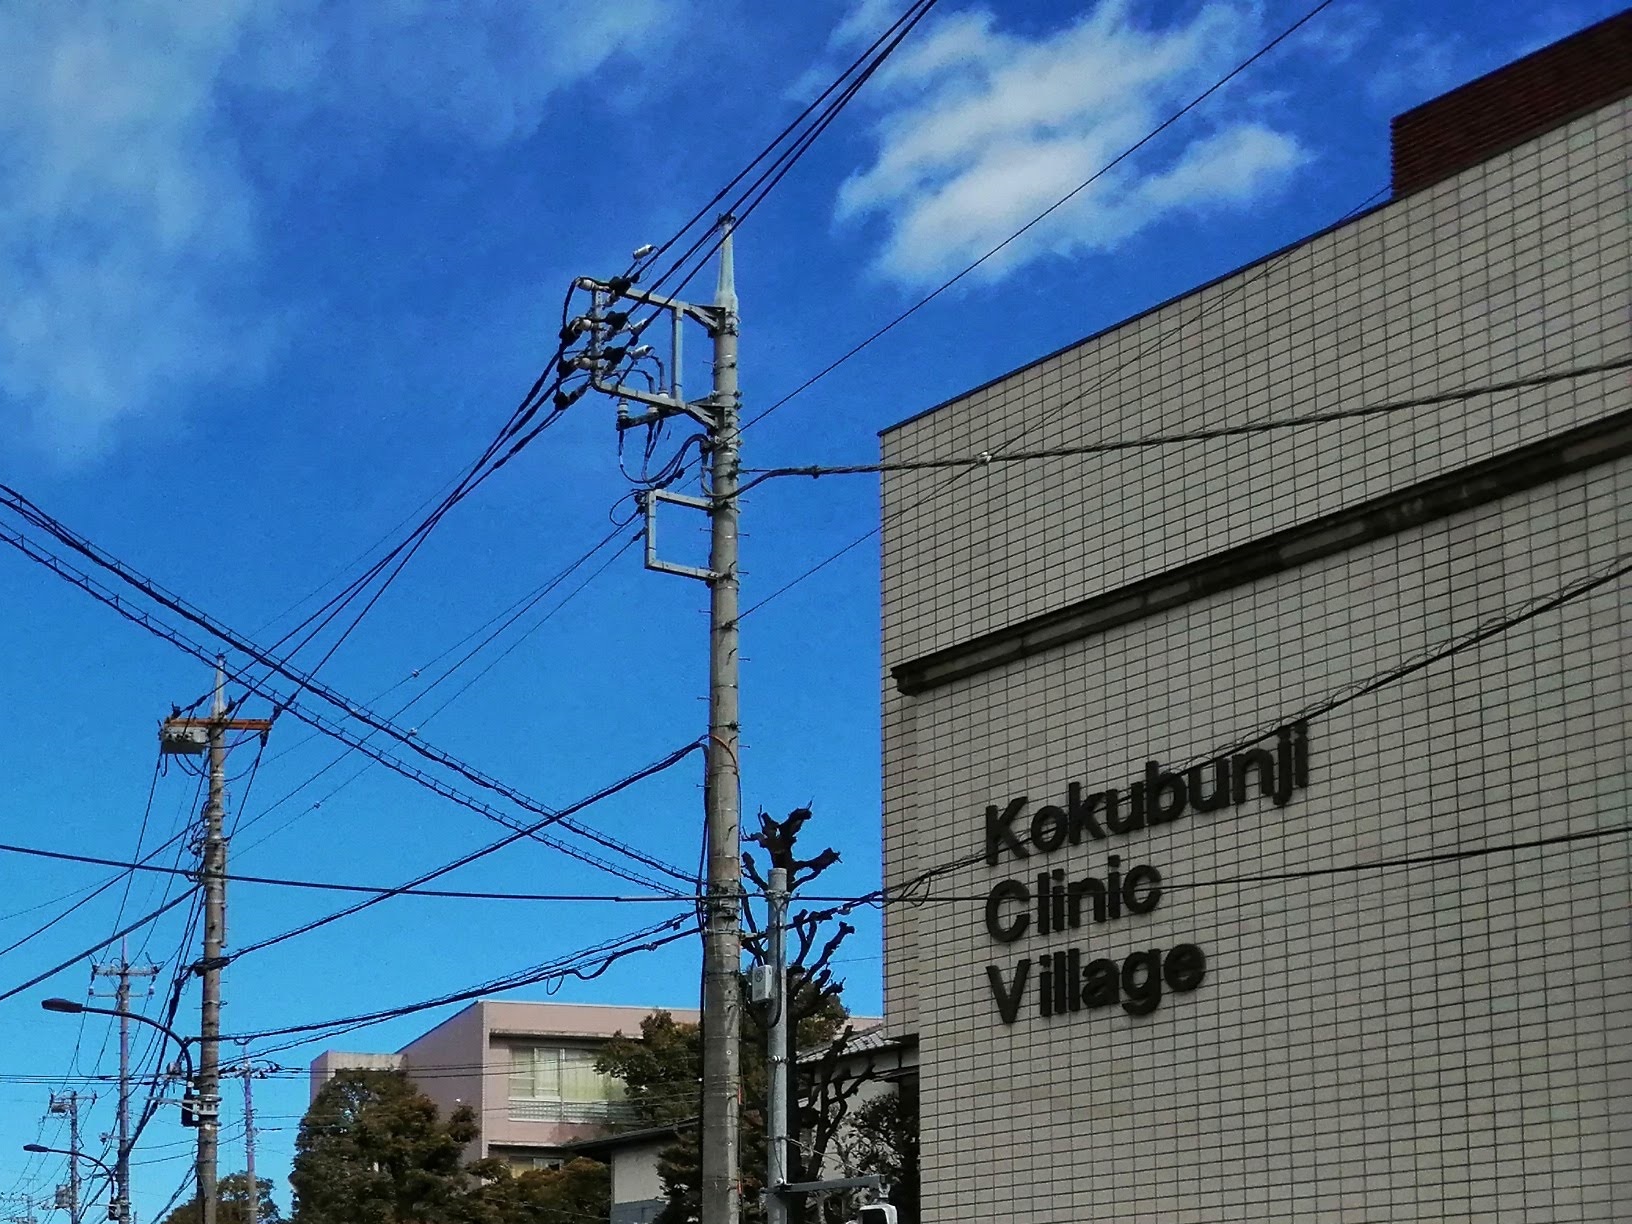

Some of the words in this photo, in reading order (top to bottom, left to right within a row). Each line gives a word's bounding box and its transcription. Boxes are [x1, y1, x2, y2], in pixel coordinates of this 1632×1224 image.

[985, 718, 1310, 866] Kokubunji
[985, 854, 1163, 943] Clinic
[985, 943, 1207, 1025] Village
